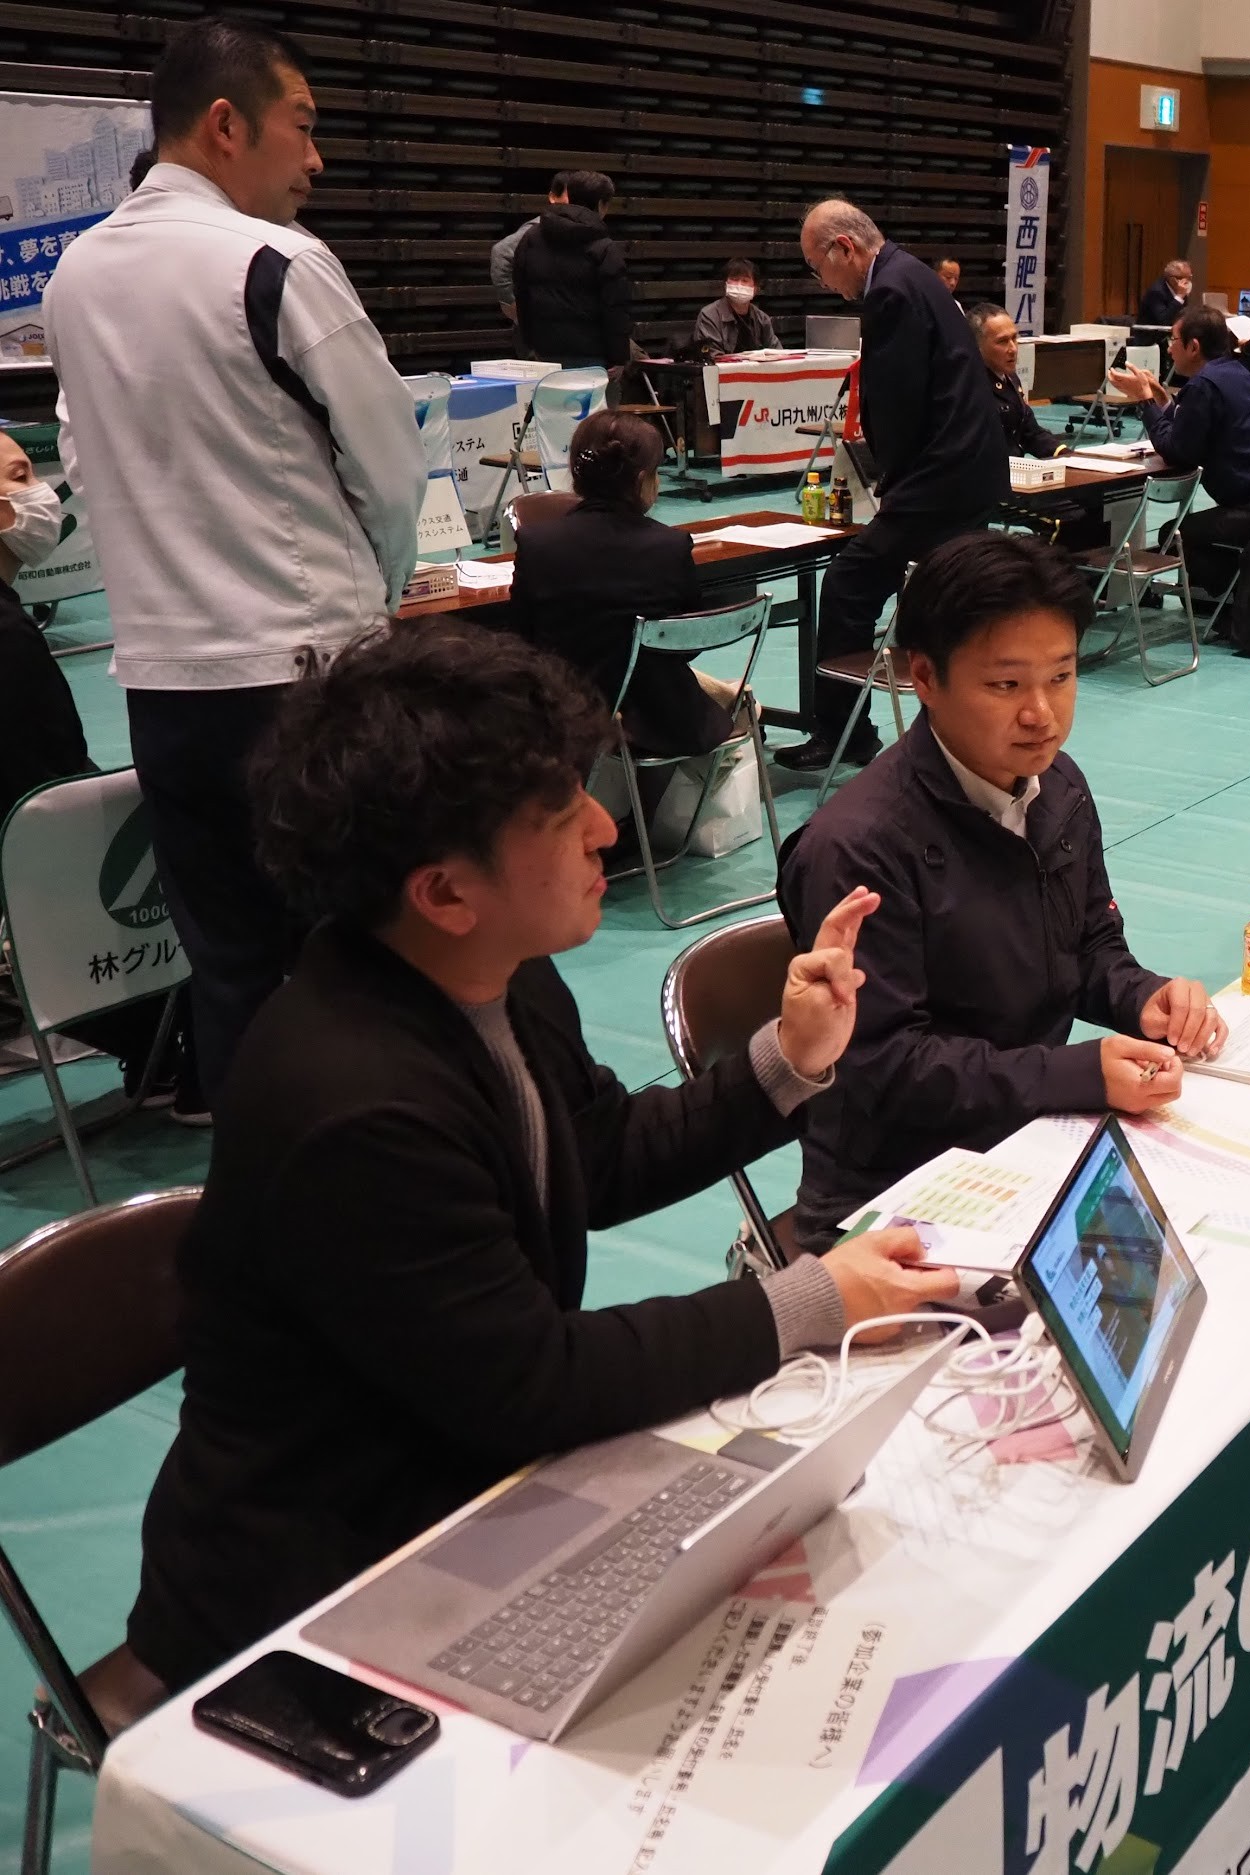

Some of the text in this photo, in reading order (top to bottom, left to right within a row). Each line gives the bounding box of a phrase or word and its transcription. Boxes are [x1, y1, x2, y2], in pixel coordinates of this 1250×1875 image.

[754, 407, 769, 423] JR
[18, 560, 92, 581] 昭和自動車株式会社
[89, 937, 184, 984] 林グル
